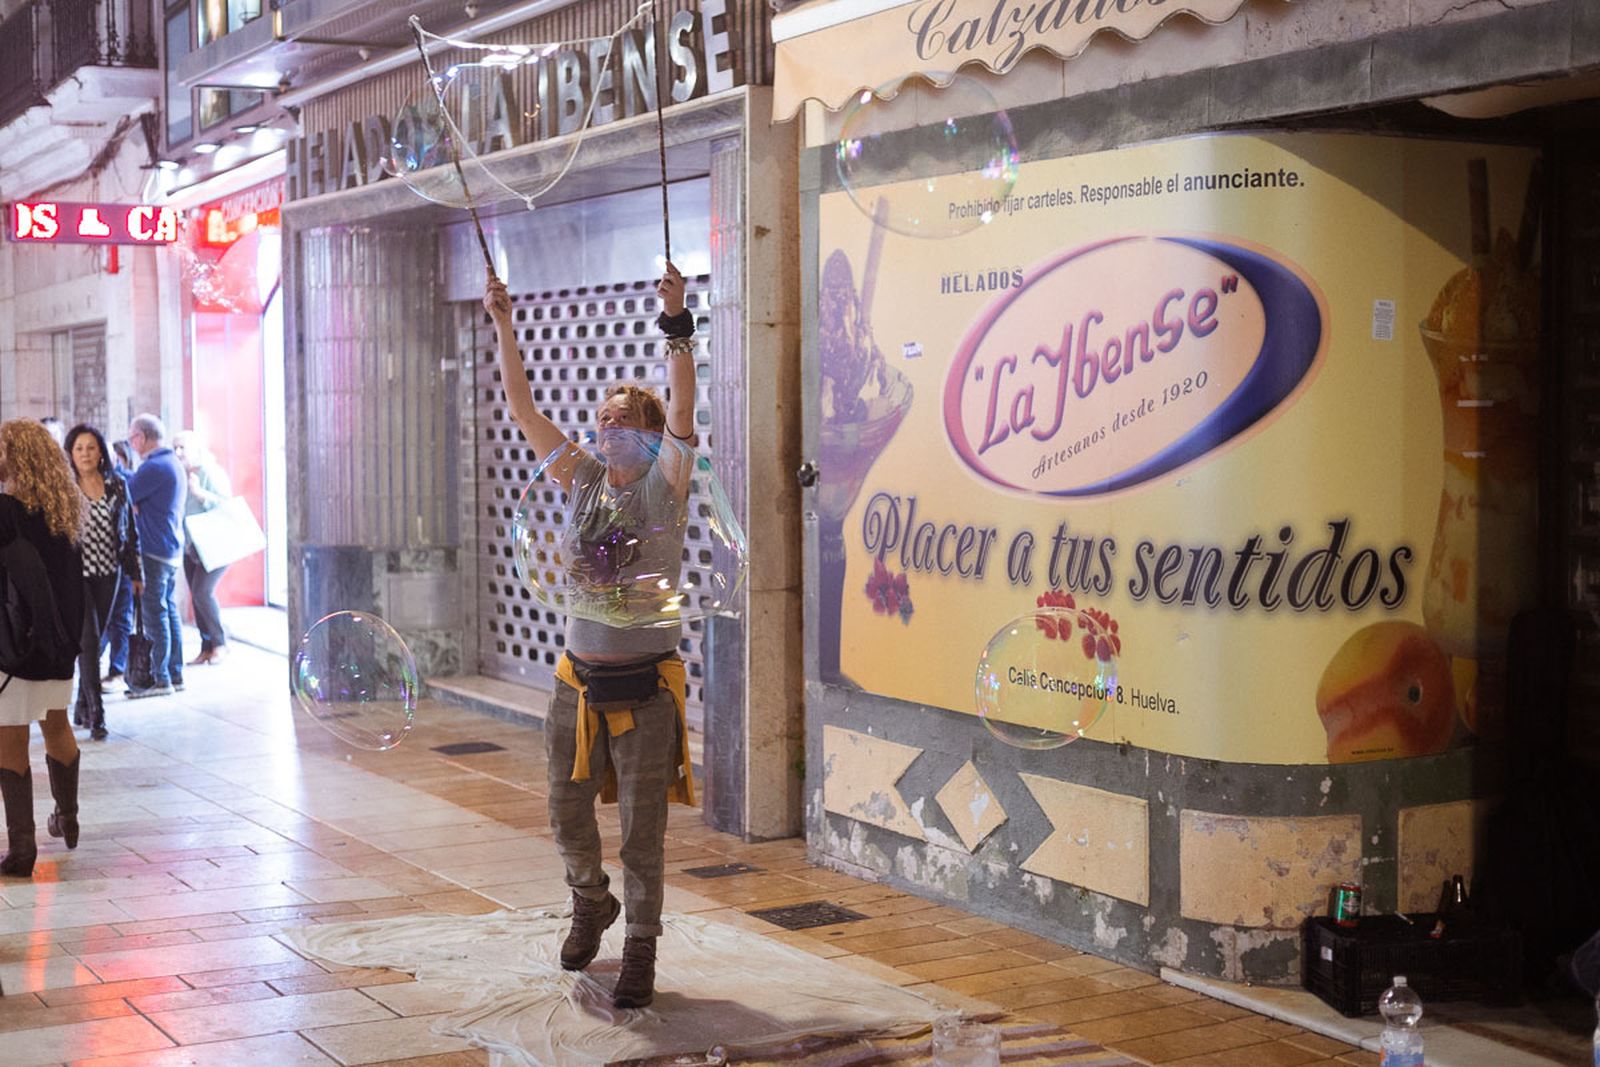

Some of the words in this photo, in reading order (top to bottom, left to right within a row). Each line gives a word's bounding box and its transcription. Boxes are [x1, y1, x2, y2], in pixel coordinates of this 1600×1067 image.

[907, 0, 1162, 69] Calza
[462, 72, 513, 159] LA
[539, 0, 735, 141] IBENSE
[1028, 188, 1077, 209] carteles.
[1080, 174, 1162, 205] Responsable
[1166, 173, 1179, 193] el
[1184, 168, 1305, 192] anunciante.
[940, 266, 1024, 294] HELADOS
[1031, 425, 1106, 480] Artesanos
[1112, 398, 1155, 433] desde
[1162, 371, 1208, 406] 1920
[862, 492, 997, 579] Placer
[1007, 531, 1034, 586] a
[1049, 520, 1117, 596] tus
[1128, 518, 1414, 611] sentidos
[1131, 687, 1180, 715] Huelva.
